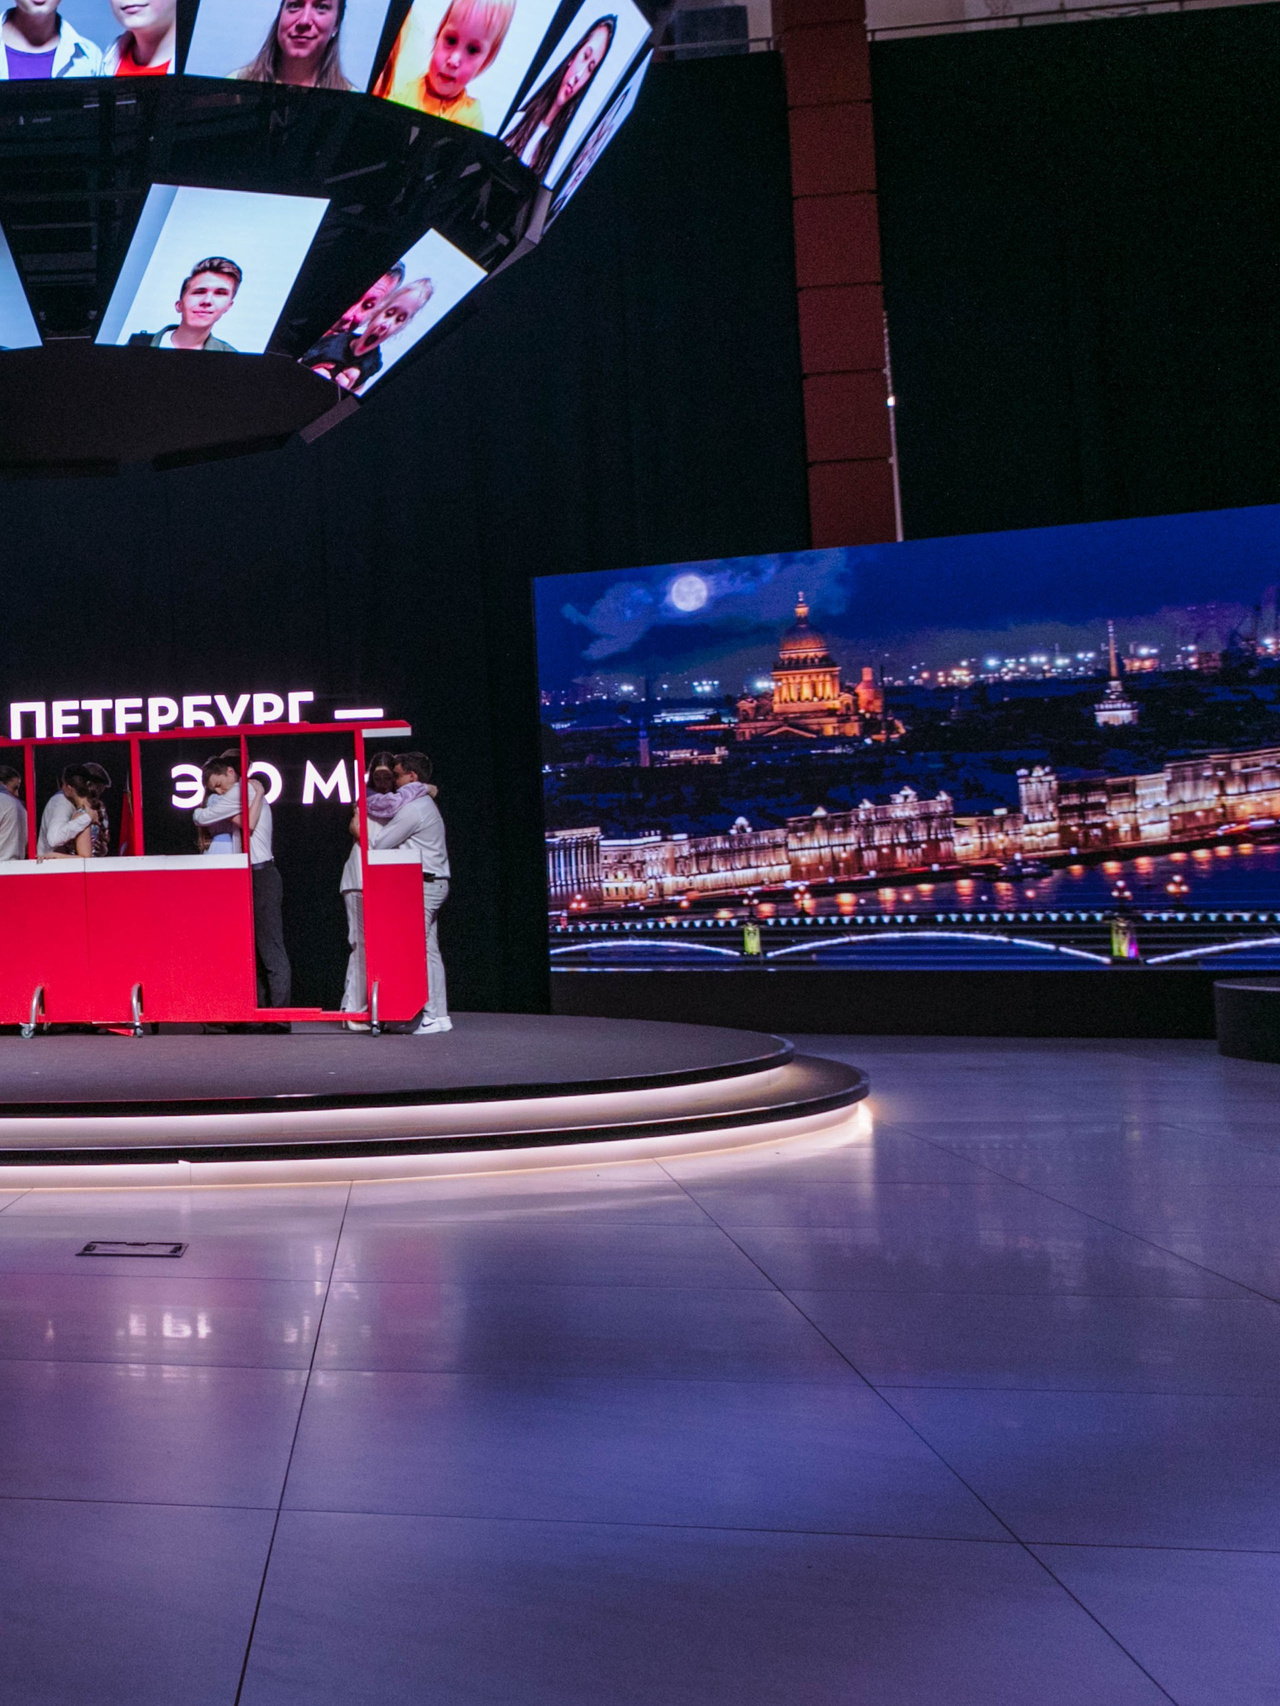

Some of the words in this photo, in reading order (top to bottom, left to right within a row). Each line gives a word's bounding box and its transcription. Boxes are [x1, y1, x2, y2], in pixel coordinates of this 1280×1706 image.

[9, 691, 314, 740] ПЕТЕРБУРГ
[171, 763, 283, 809] ЭО
[302, 758, 369, 804] М
